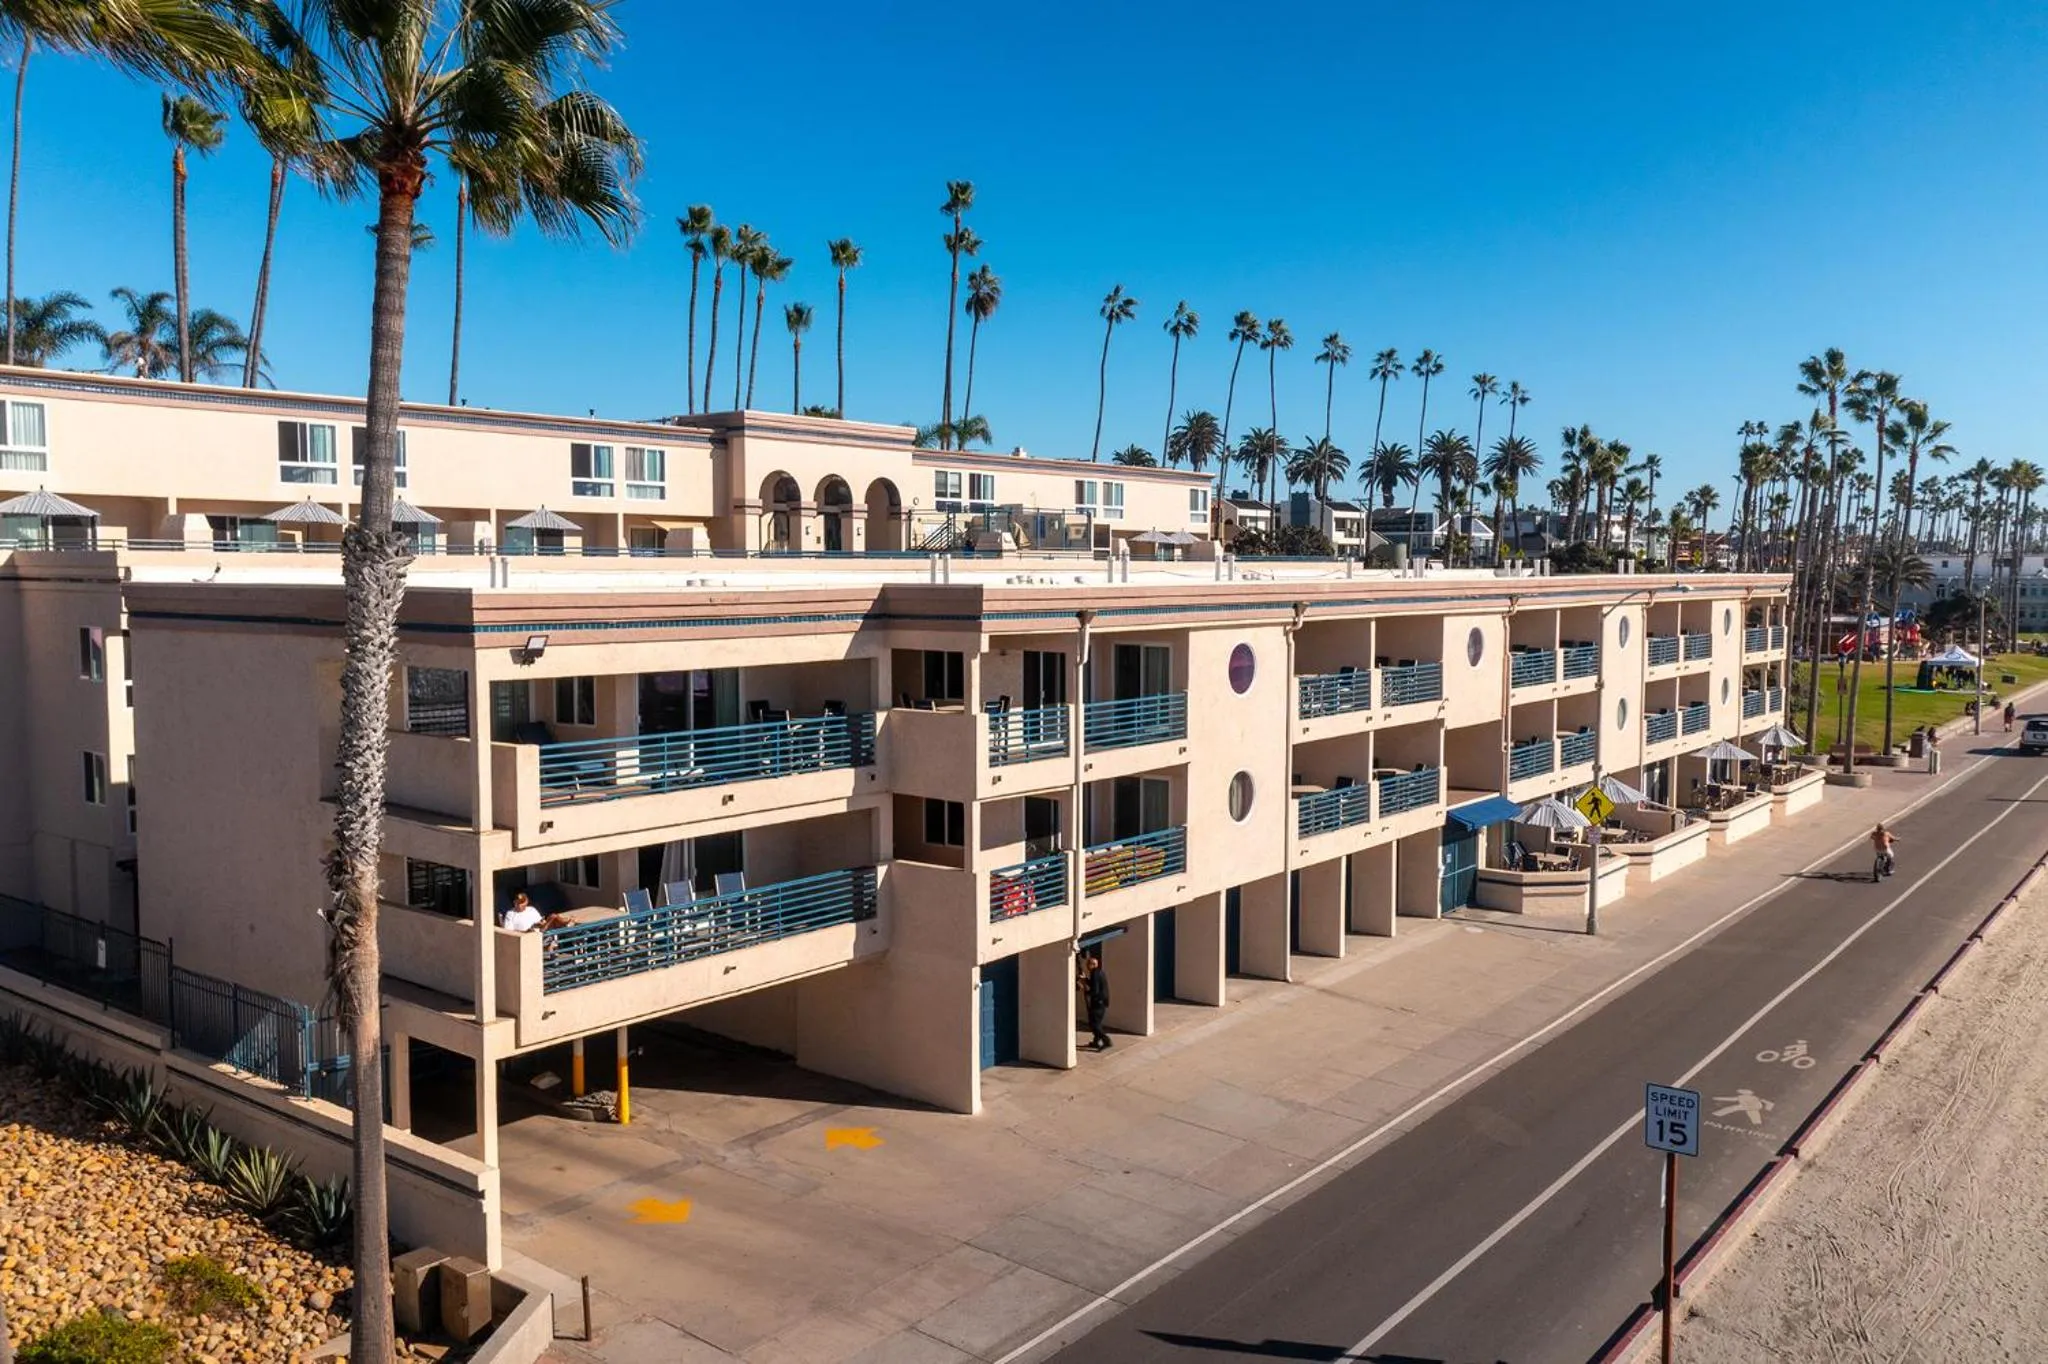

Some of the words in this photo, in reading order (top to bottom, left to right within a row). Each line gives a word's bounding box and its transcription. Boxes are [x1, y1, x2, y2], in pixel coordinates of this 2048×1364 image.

[1650, 1091, 1696, 1109] SPEED
[1655, 1105, 1690, 1121] LIMIT
[1656, 1119, 1688, 1146] 15
